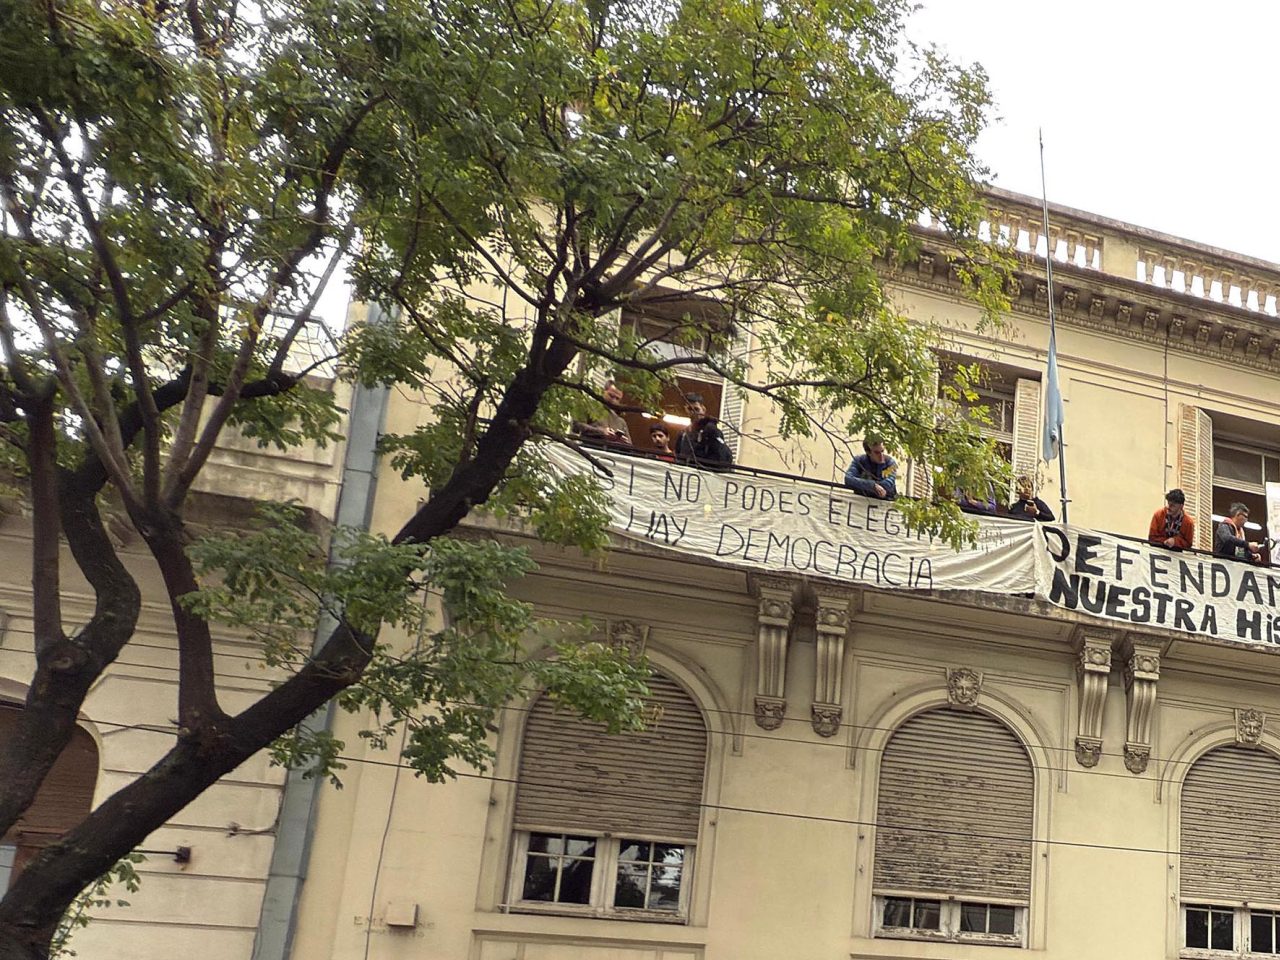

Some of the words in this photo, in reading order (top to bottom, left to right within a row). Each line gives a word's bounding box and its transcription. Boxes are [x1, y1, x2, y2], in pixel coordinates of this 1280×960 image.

[664, 470, 701, 503] NO
[724, 481, 812, 516] PODES
[626, 506, 688, 546] HAY
[1050, 566, 1218, 635] NUESTRA
